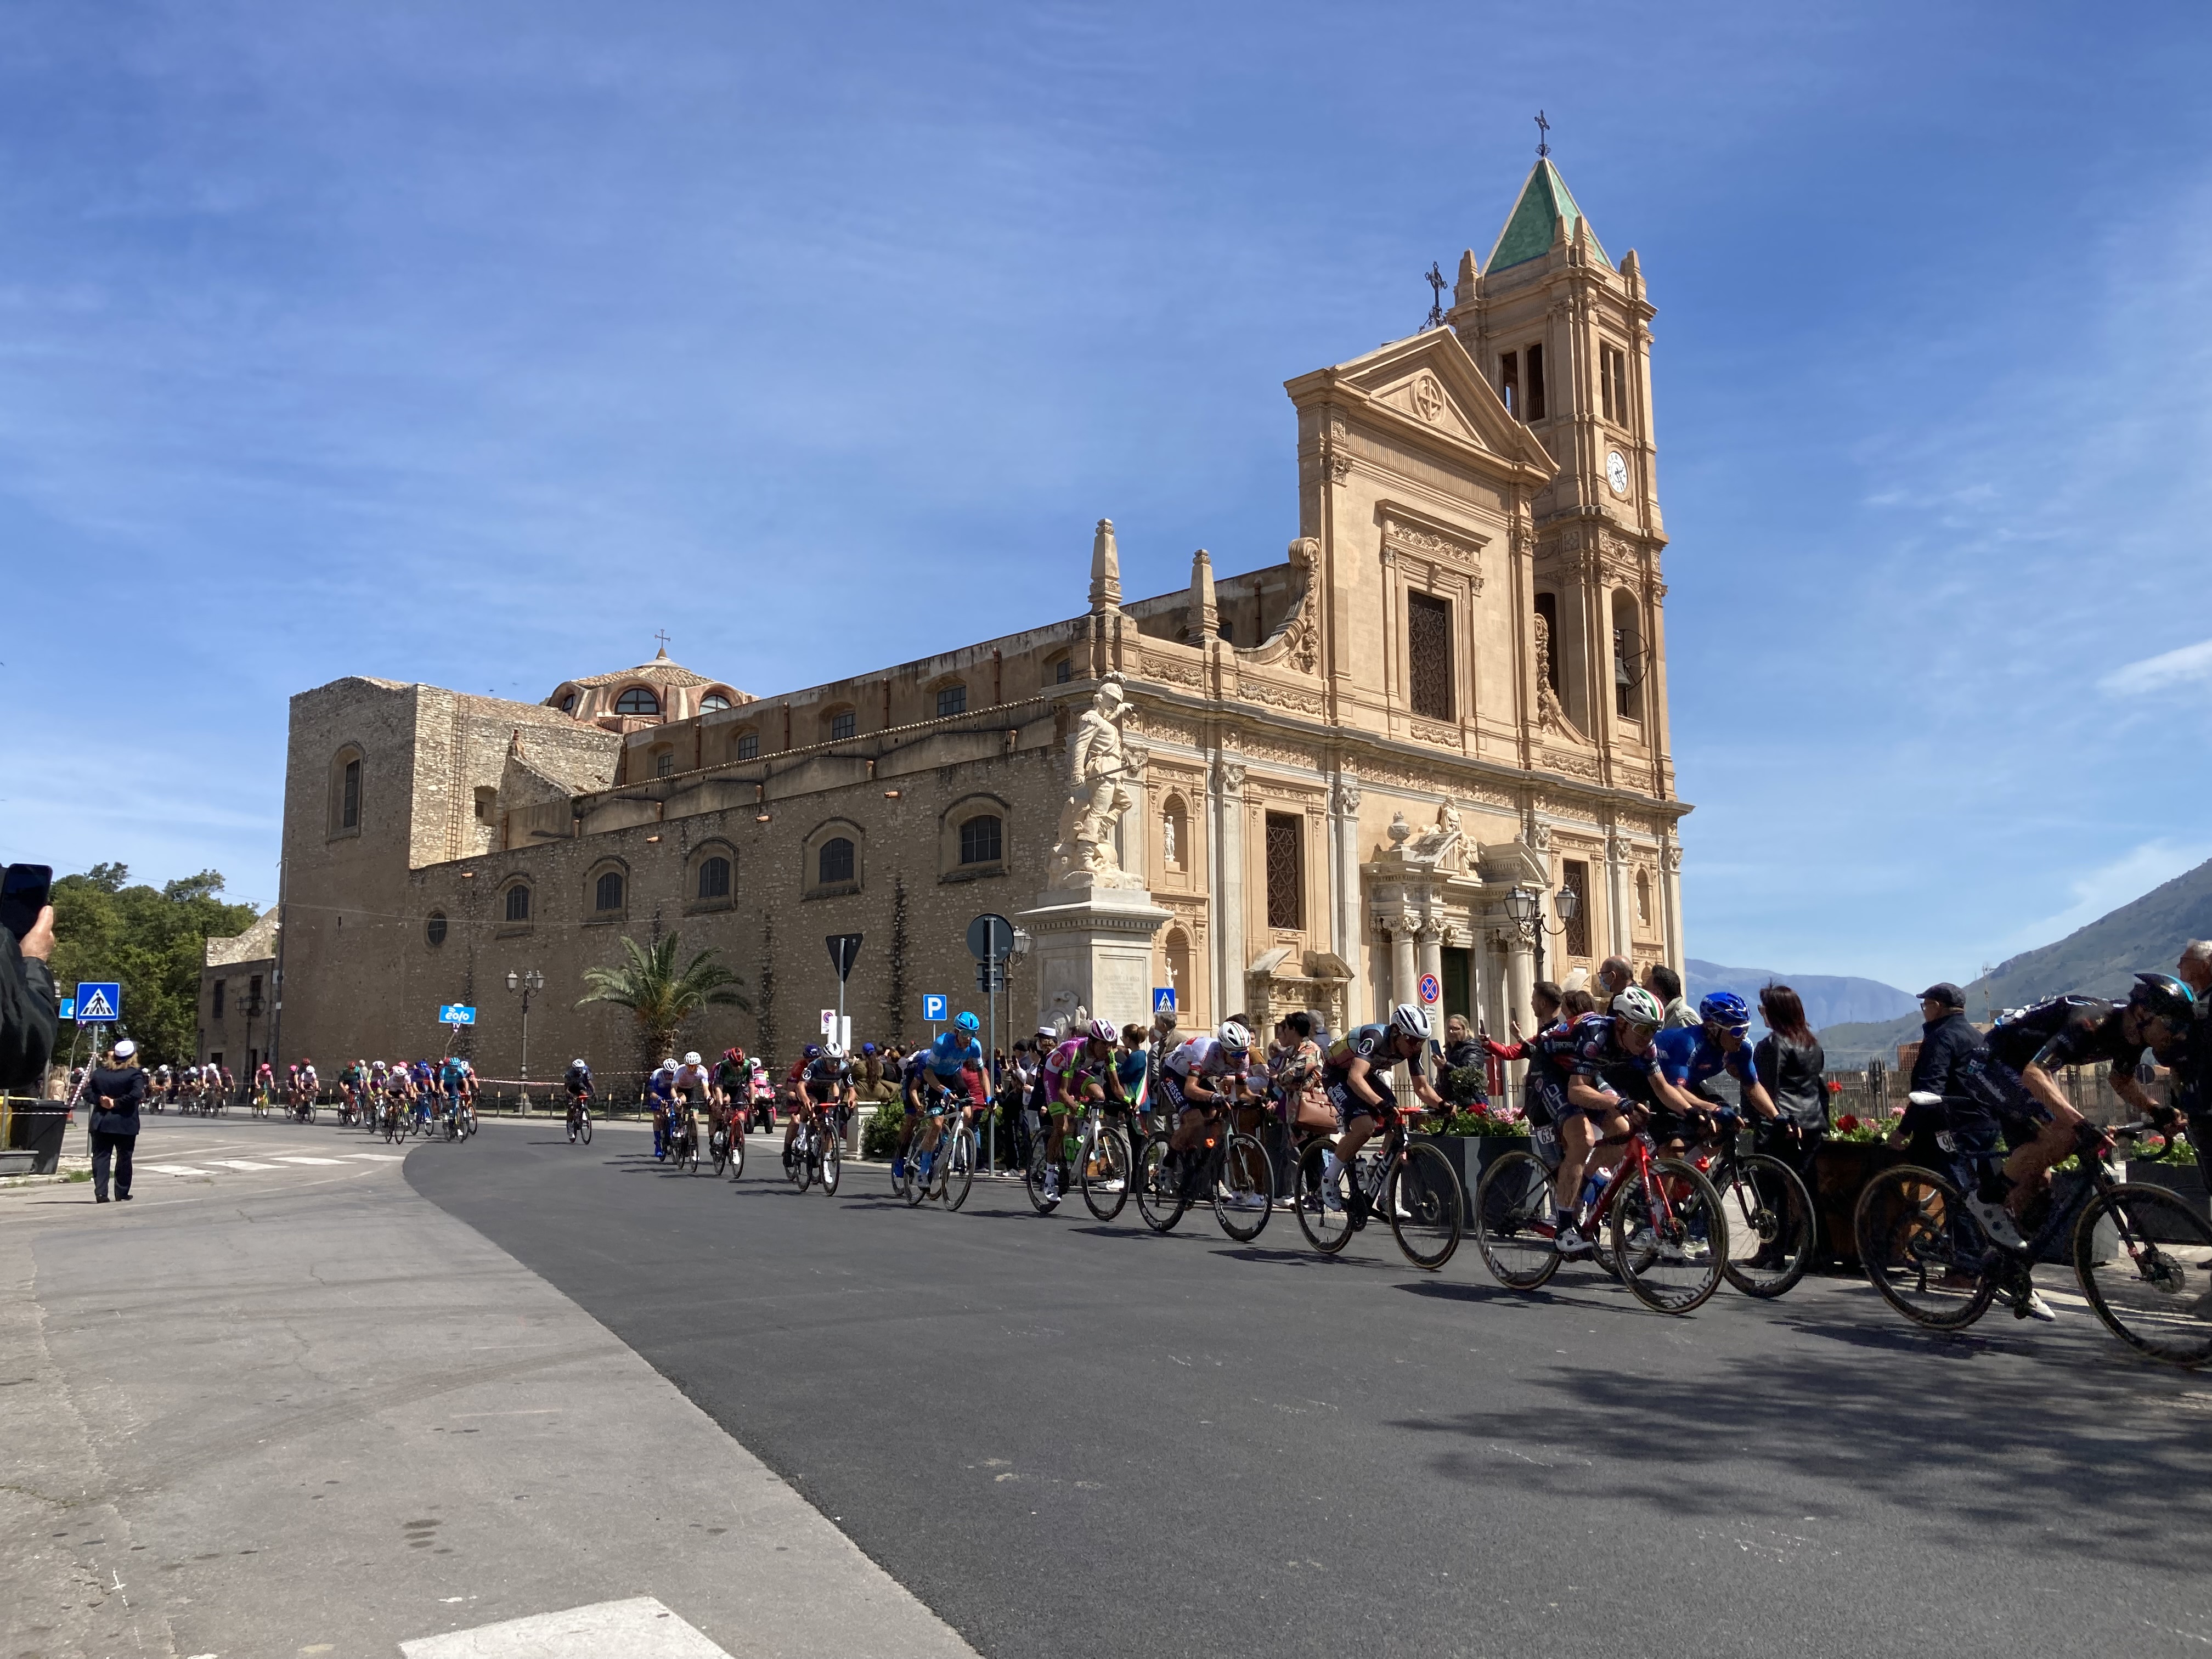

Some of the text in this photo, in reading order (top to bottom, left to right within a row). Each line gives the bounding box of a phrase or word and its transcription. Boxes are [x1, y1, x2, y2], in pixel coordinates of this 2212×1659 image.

[927, 997, 943, 1018] P
[1166, 1080, 1184, 1104] BIESSE
[1541, 1128, 1551, 1143] 63
